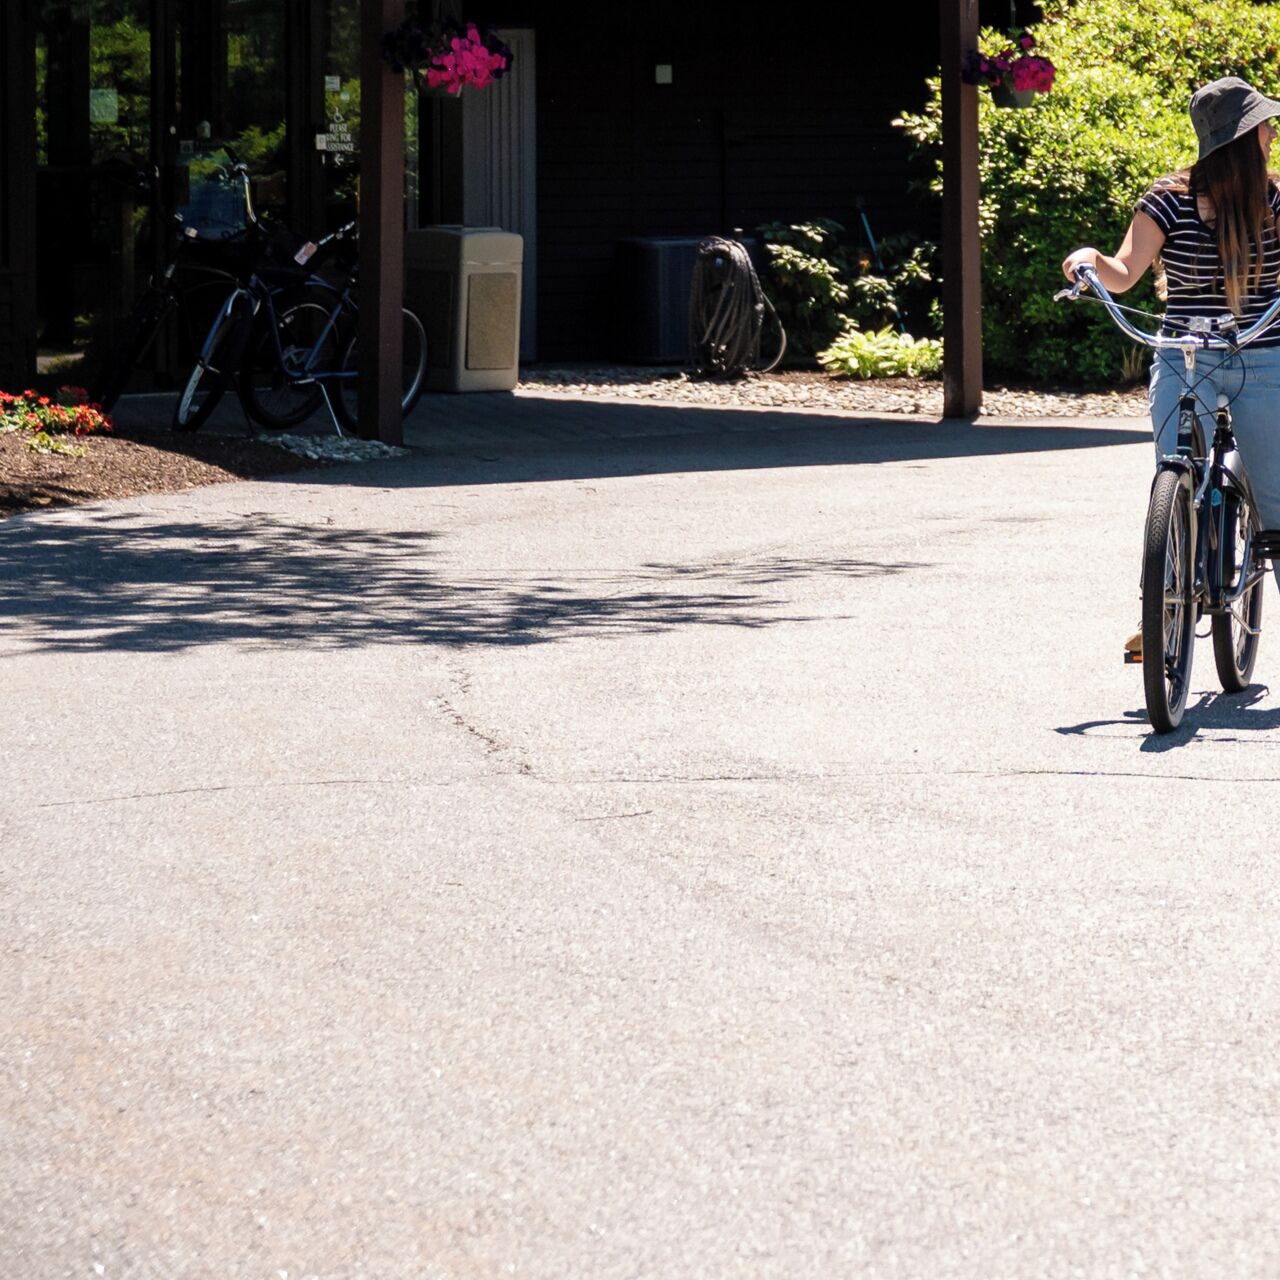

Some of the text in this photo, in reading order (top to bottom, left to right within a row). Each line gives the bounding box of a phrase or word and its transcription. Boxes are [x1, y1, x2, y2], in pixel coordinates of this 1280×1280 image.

[329, 123, 348, 133] PLEASE
[340, 133, 352, 142] FOR
[326, 142, 354, 152] SSISTANCE
